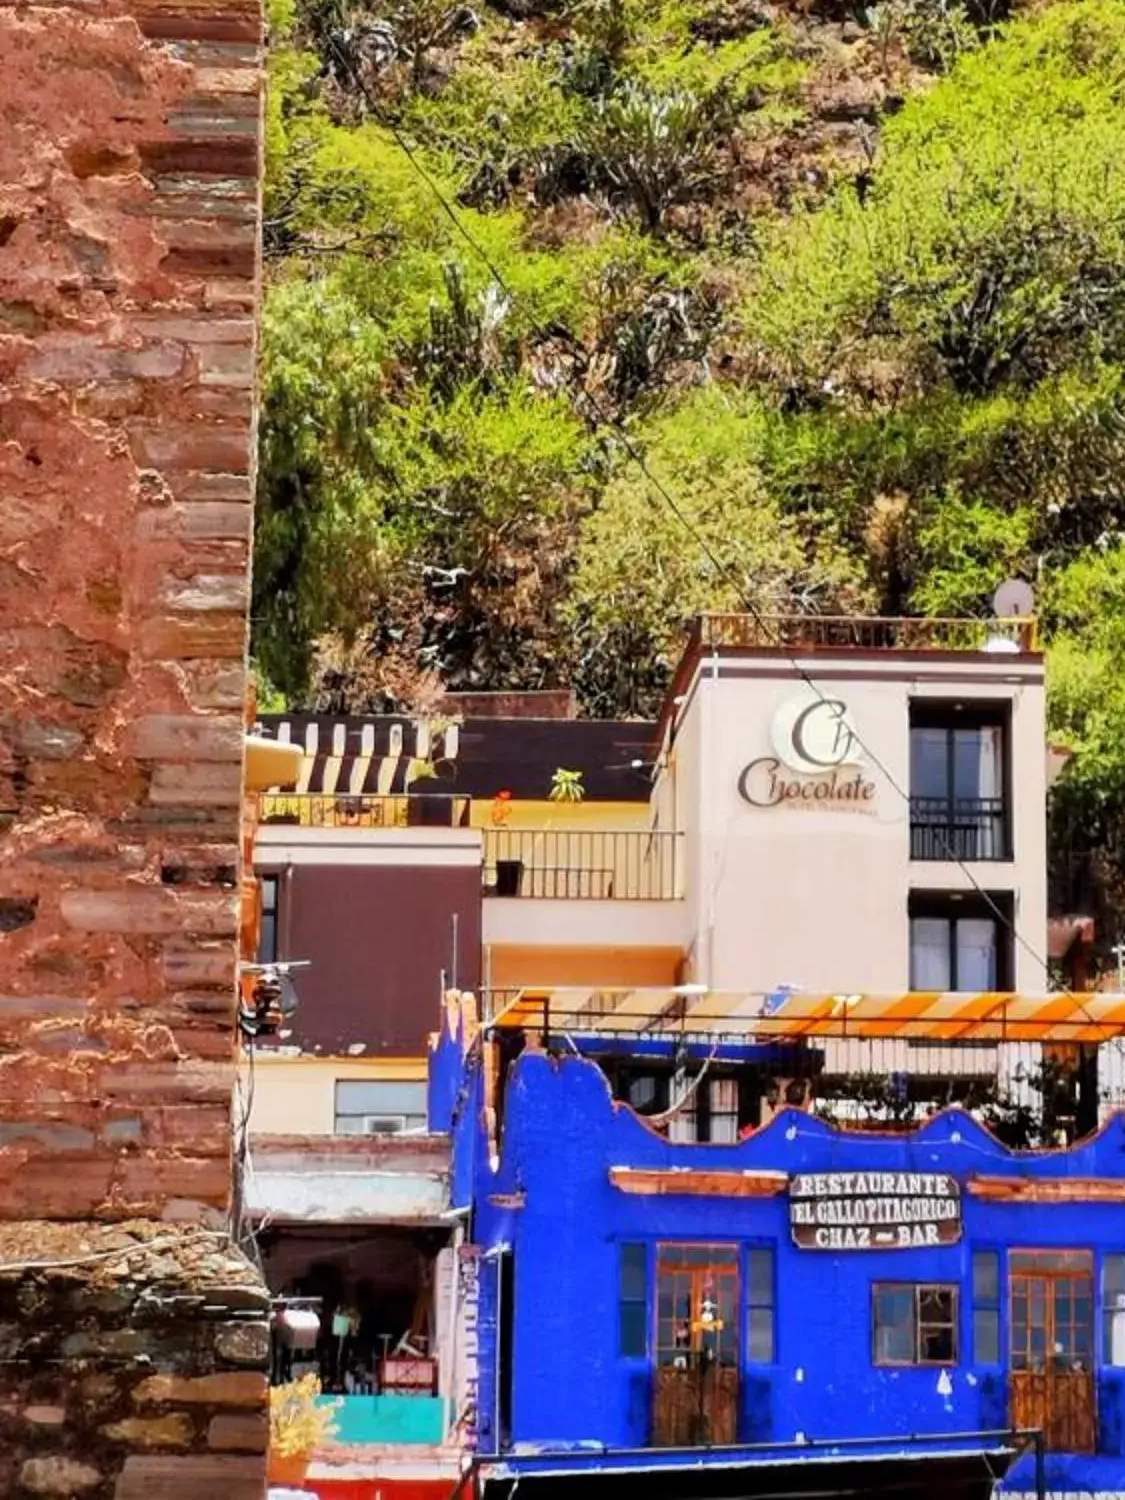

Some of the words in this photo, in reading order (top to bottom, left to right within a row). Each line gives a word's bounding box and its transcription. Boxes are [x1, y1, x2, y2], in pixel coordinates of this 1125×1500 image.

[737, 757, 876, 807] Chocolate
[798, 1173, 950, 1196] RESTAURANTE
[794, 1201, 815, 1224] EL
[815, 1227, 871, 1248] CHAZ
[897, 1223, 939, 1247] BAR
